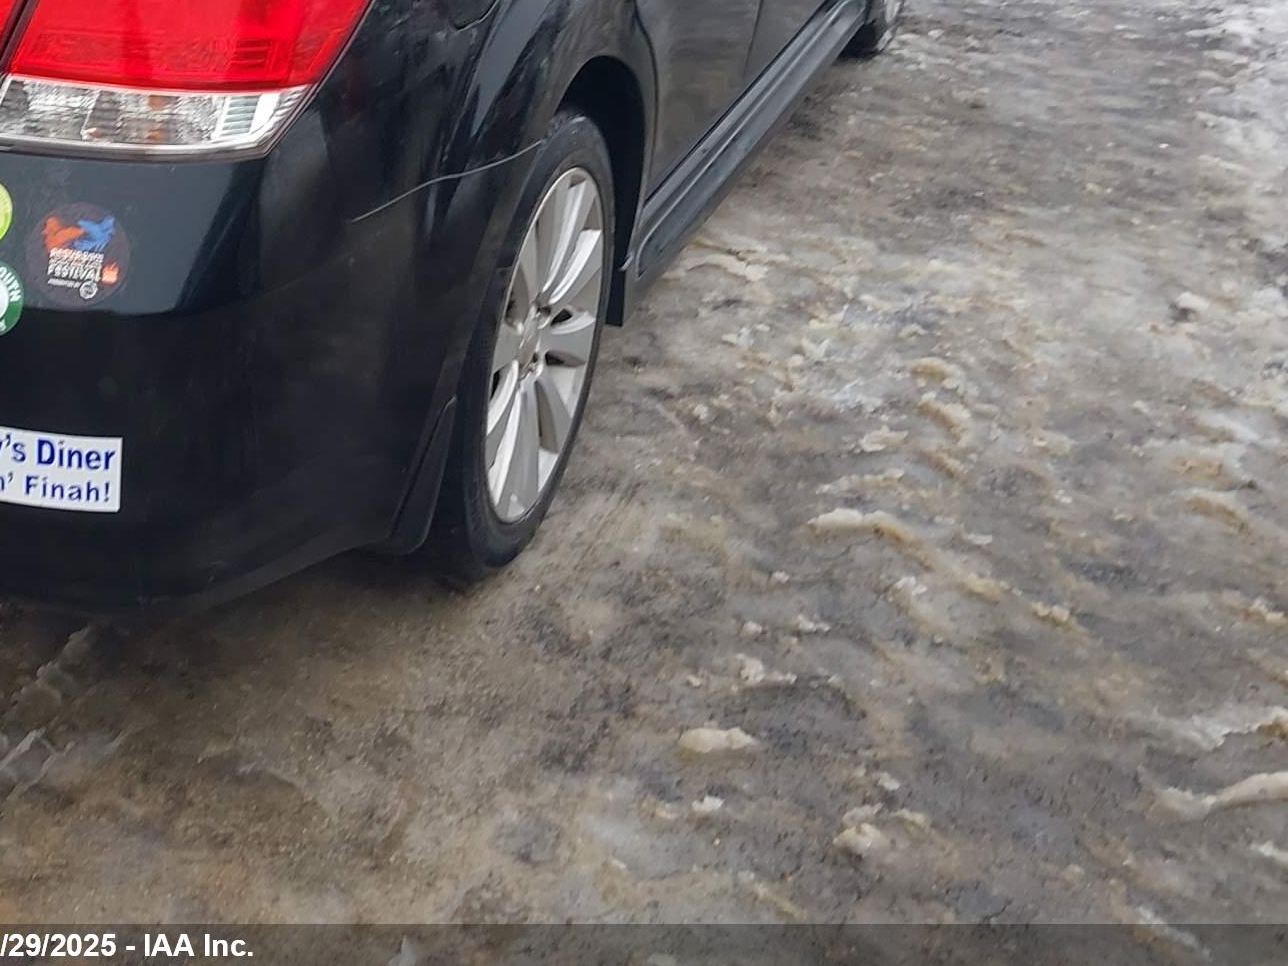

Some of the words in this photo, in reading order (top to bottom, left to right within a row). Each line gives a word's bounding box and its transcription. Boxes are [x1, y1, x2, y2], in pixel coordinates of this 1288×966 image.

[48, 264, 101, 283] FESTIVAL
[37, 439, 117, 471] Diner
[25, 475, 111, 503] Finah!
